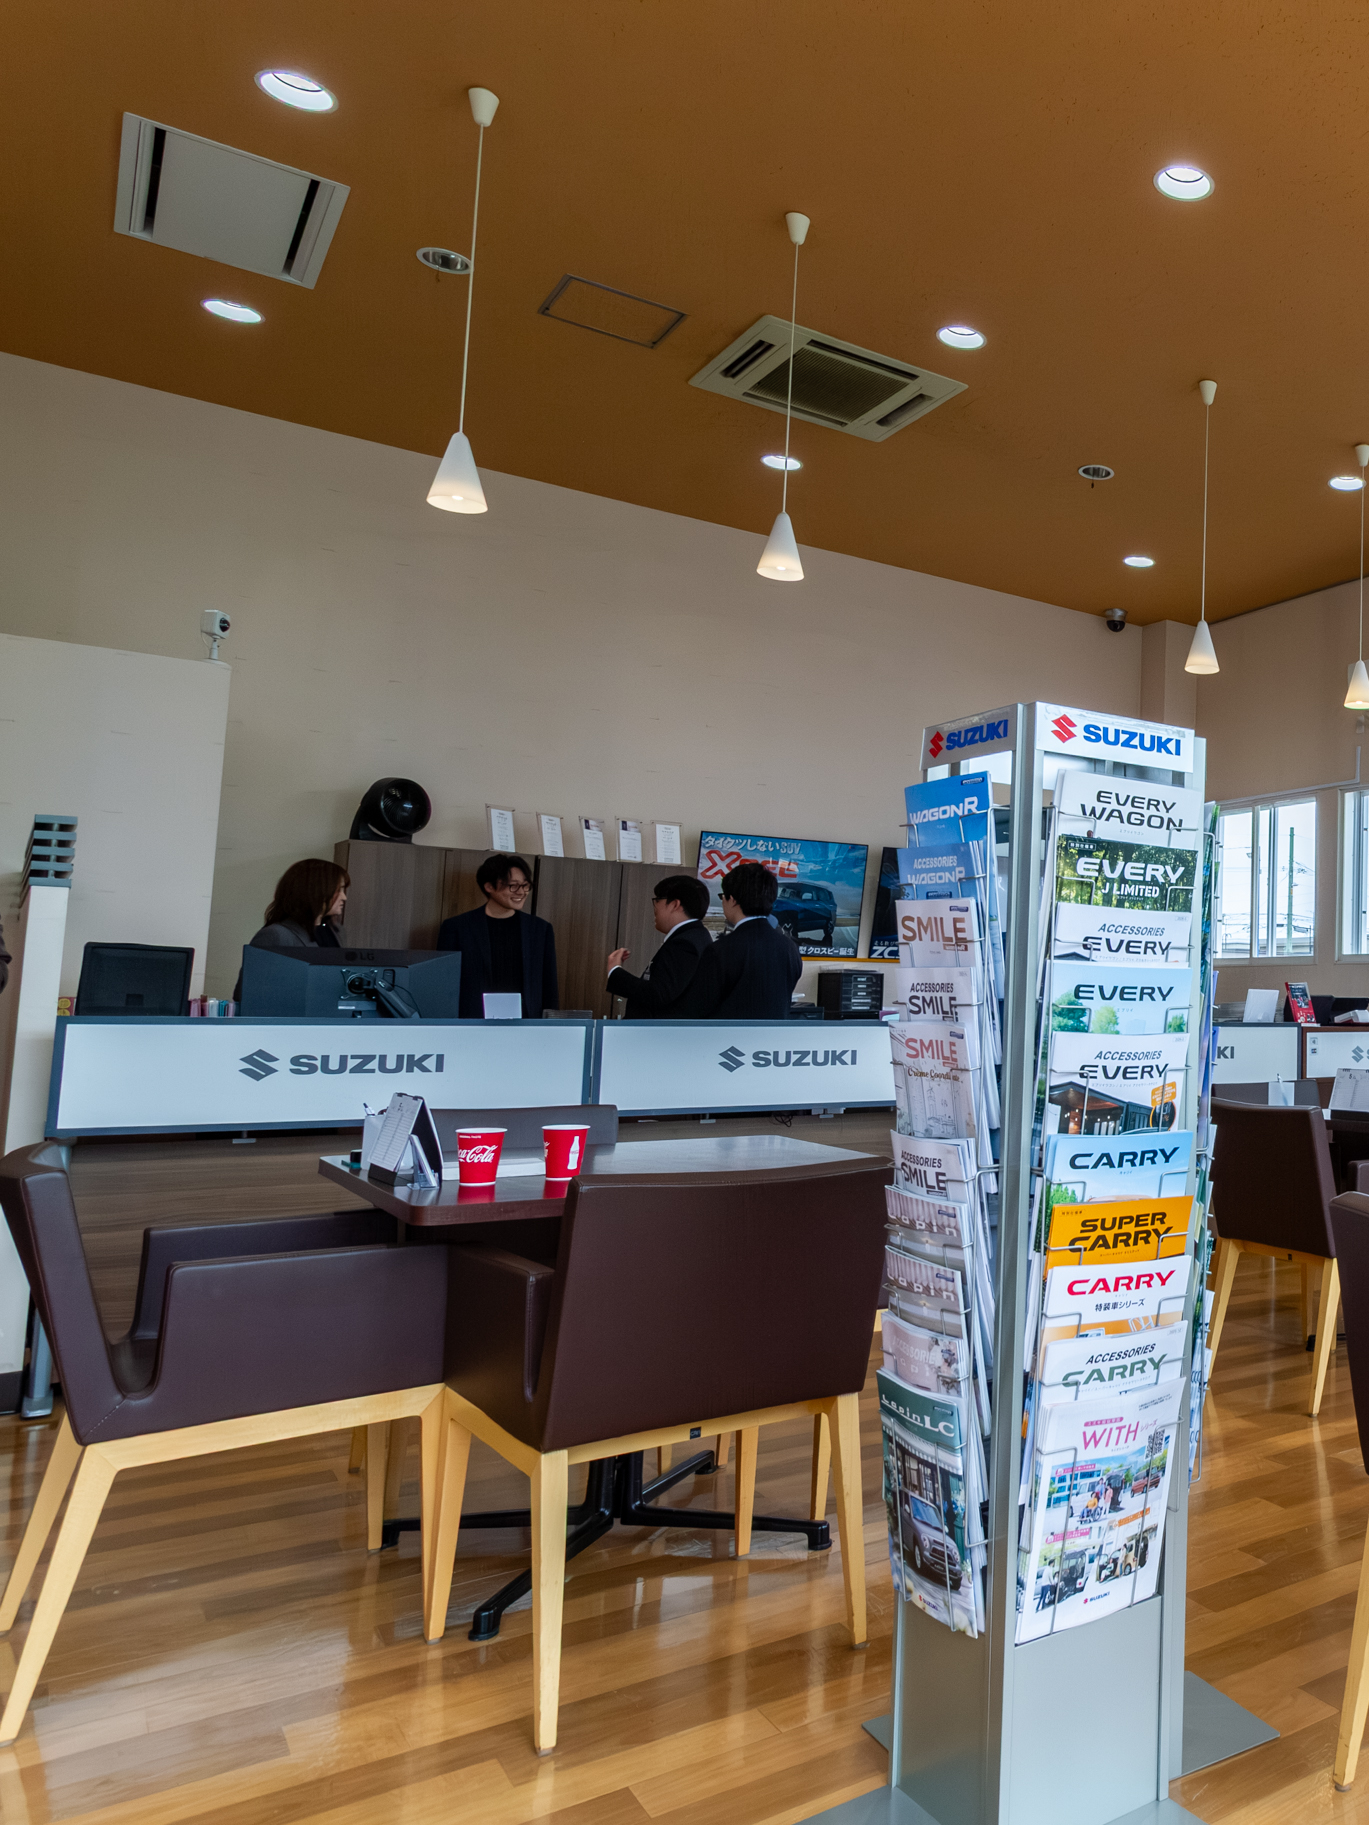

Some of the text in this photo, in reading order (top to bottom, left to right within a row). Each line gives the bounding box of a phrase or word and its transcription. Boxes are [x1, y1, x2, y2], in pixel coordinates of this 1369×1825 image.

[945, 719, 1008, 750] SUZUKI
[1083, 724, 1181, 756] SUZUKI
[1096, 790, 1176, 813] EVERY
[1080, 804, 1183, 832] WAGON
[913, 856, 958, 869] ACCESSORIES
[1077, 857, 1185, 884] EVERY
[1101, 882, 1159, 898] J LIMITED
[901, 915, 968, 943] SMILE
[1098, 923, 1165, 937] ACCESSORIES
[871, 946, 900, 959] ZC
[1082, 936, 1172, 955] EVERY
[910, 982, 953, 993] ACCESSORIES
[1074, 984, 1174, 1001] EVERY
[752, 1049, 857, 1067] SUZUKI
[905, 1037, 958, 1062] SMILE
[1094, 1051, 1162, 1061] ACCESSORIES
[289, 1053, 445, 1075] SUZUKI
[1079, 1064, 1169, 1080] EVERY
[901, 1150, 942, 1169] ACCESSORIES
[1070, 1147, 1180, 1169] CARRY
[900, 1162, 947, 1190] SMILE
[1080, 1212, 1167, 1233] SUPER
[1069, 1226, 1173, 1252] CARRY
[1067, 1270, 1176, 1296] CARRY
[1095, 1299, 1145, 1312] 特装車シリーズ
[1085, 1343, 1156, 1365] ACCESSORIES
[1062, 1353, 1168, 1387] CARRY
[1082, 1421, 1140, 1450] WITH
